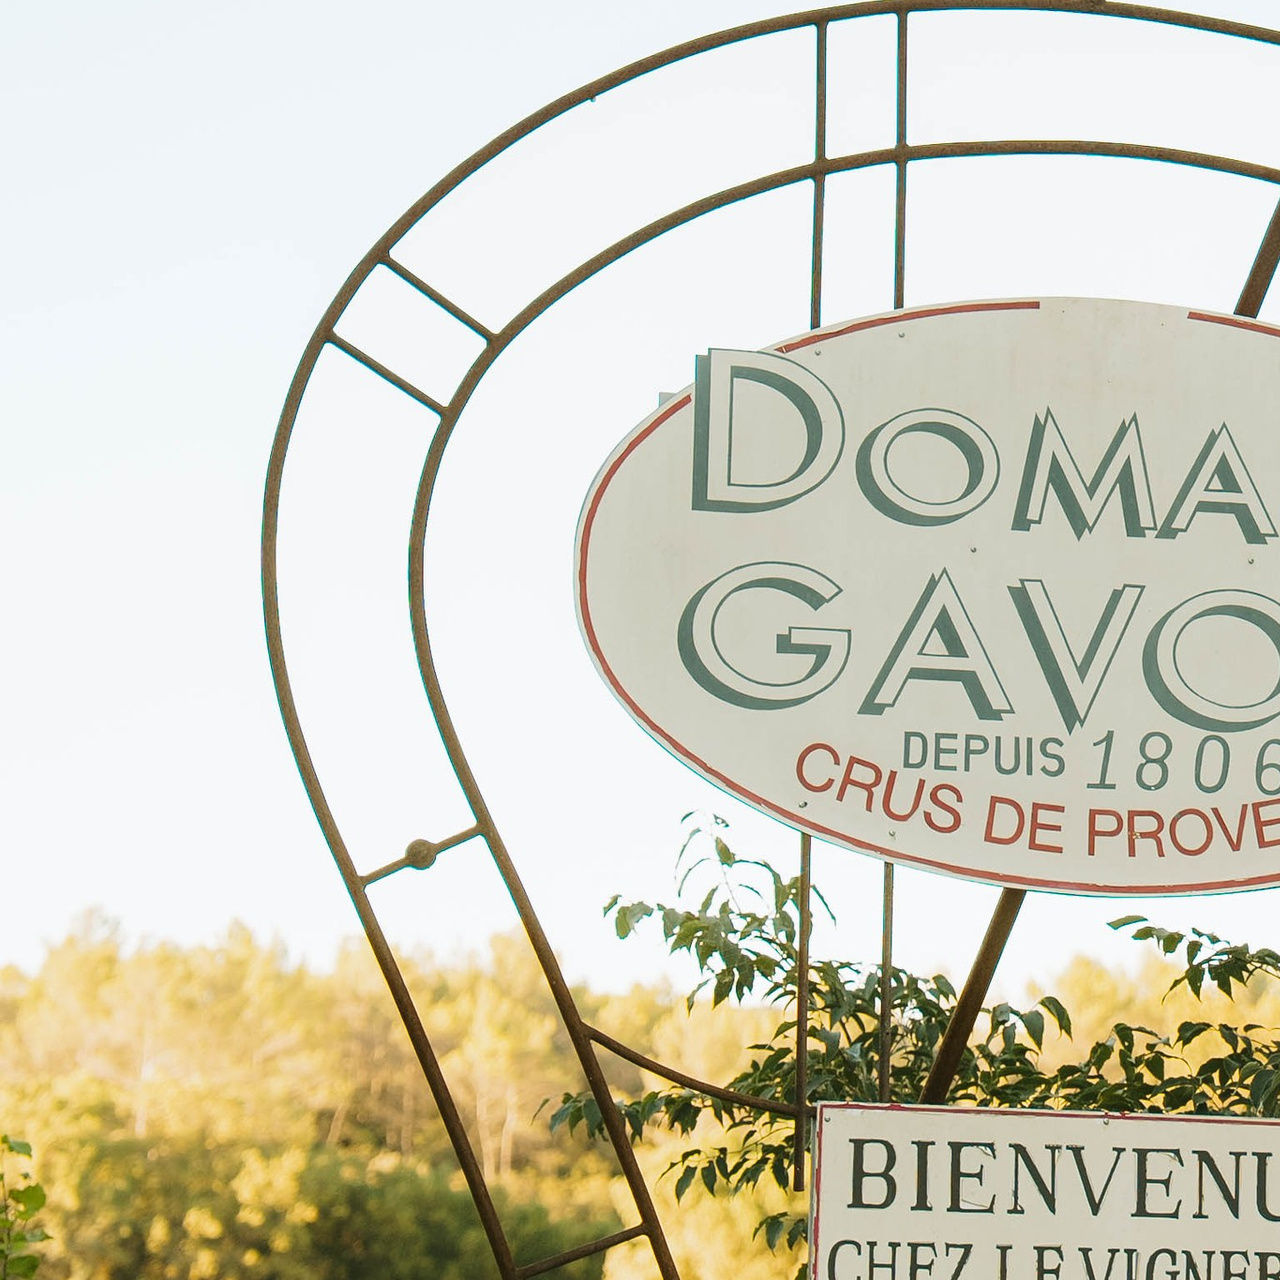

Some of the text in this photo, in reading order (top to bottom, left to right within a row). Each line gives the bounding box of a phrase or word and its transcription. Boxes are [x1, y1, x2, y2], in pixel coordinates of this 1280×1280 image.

[903, 730, 1066, 778] DEPUIS
[796, 741, 963, 835] CRUS
[984, 796, 1066, 855] DE
